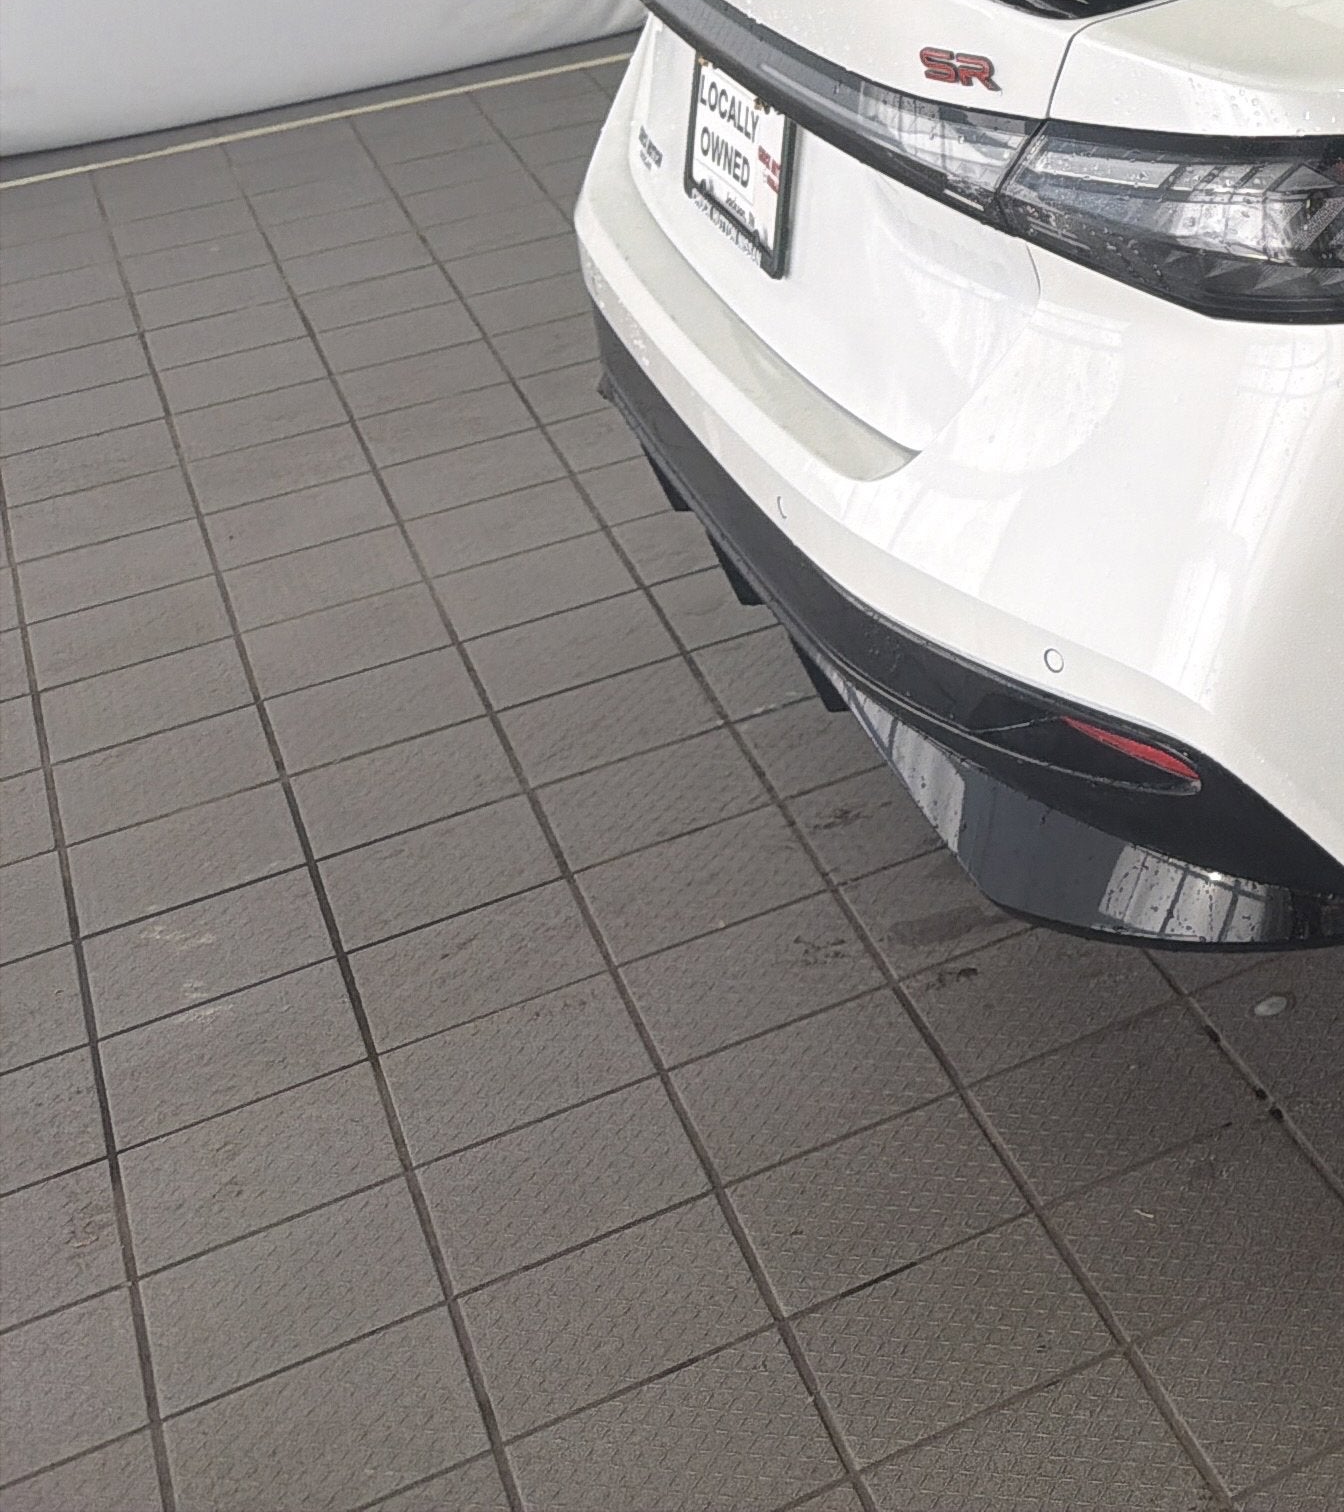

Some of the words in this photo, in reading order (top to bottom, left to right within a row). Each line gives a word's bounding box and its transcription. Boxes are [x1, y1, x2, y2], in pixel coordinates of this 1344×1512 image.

[919, 46, 1002, 92] SR
[699, 73, 760, 144] LOCALLY
[700, 126, 751, 189] OWNED
